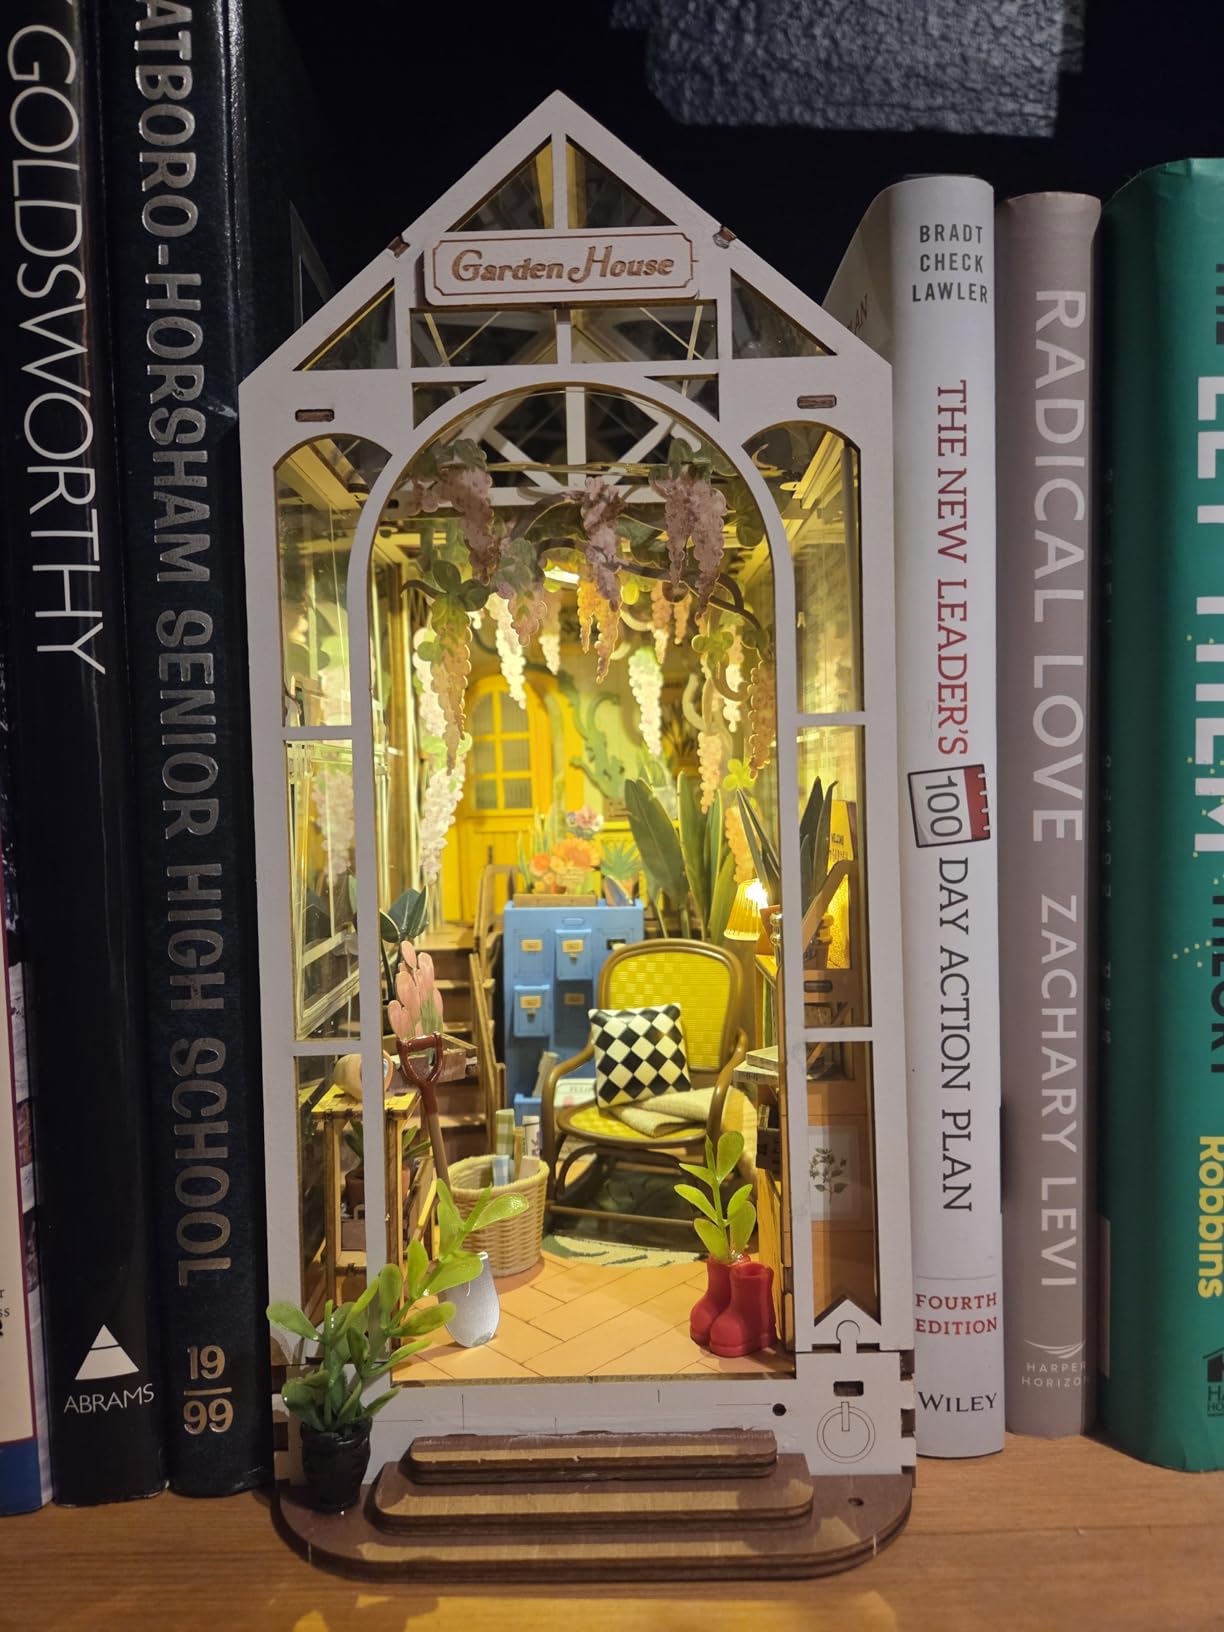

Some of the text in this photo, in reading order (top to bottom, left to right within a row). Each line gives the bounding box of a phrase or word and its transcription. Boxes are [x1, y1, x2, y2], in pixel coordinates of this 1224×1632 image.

[919, 224, 984, 244] BRADT
[451, 245, 675, 284] Garden House
[919, 253, 984, 273] CHECK
[911, 283, 988, 304] LAWLER
[8, 24, 105, 674] GOLDSWORTHY
[1032, 290, 1087, 842] RADICAL LOVE
[155, 609, 222, 840] SENIOR
[925, 379, 973, 1212] THE NEW LEADER'S 100 DAY ACTION PLAN
[167, 863, 224, 1010] HIGH
[1040, 894, 1078, 1286] ZACHARY LEVI
[170, 1037, 231, 1286] SCHOOL
[915, 1292, 998, 1311] FOURTH
[915, 1316, 998, 1336] EDITION
[187, 1344, 226, 1381] 19
[64, 1383, 155, 1414] ABRAMS
[183, 1397, 234, 1436] 99
